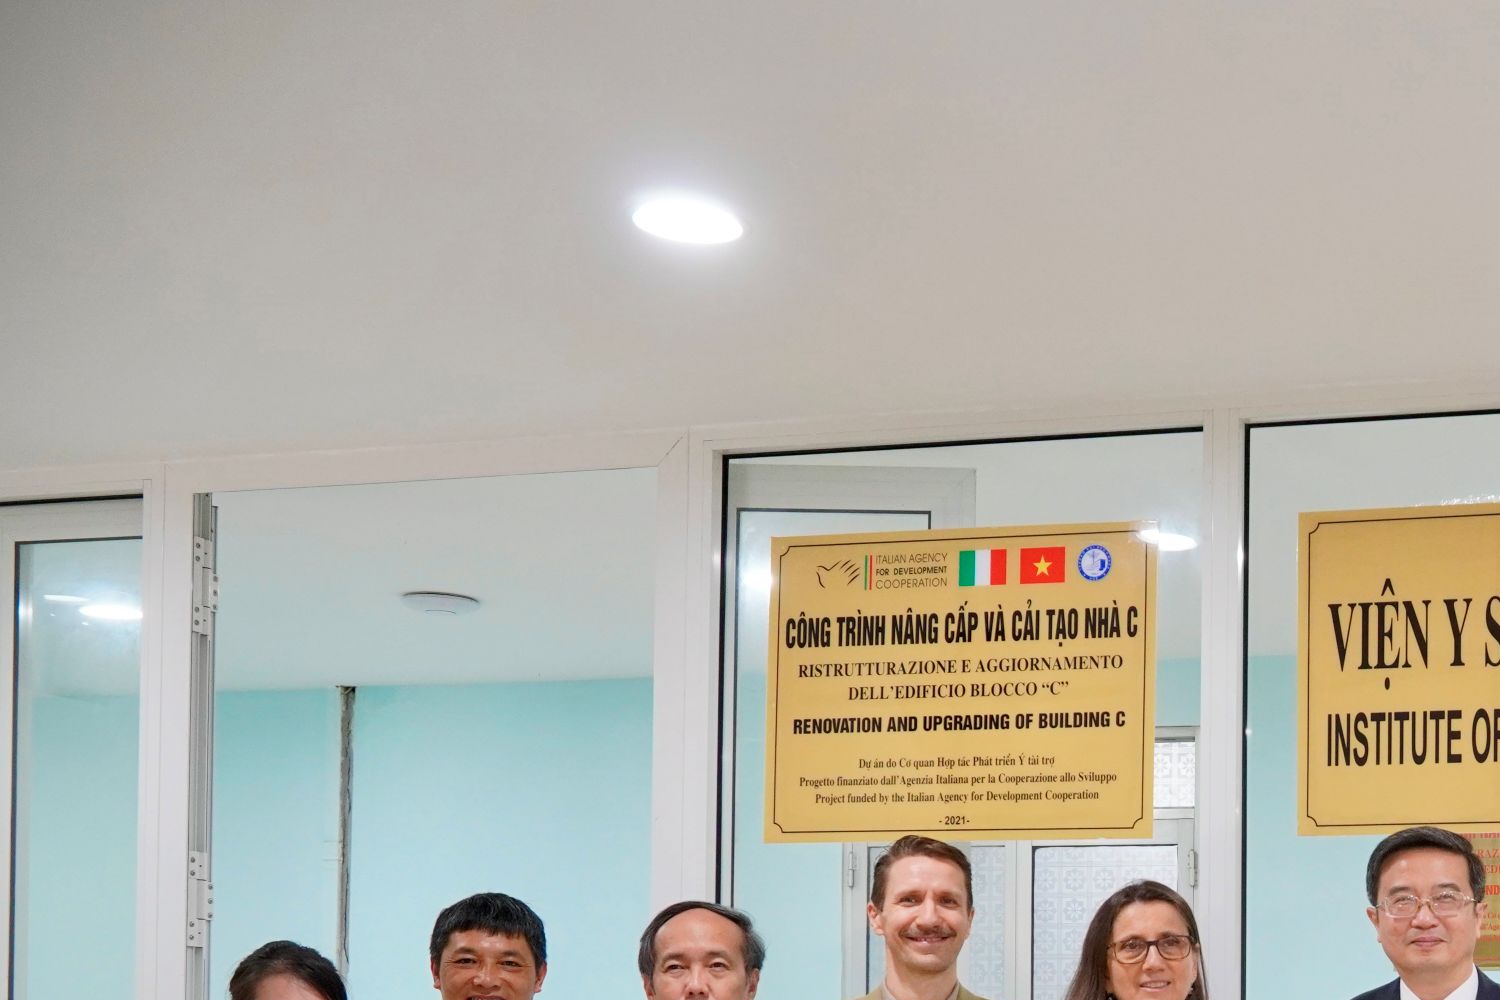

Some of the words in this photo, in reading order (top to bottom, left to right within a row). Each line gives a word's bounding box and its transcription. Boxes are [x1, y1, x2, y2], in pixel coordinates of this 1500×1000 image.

[876, 554, 906, 564] ITALIAN
[908, 552, 948, 563] AGENCY
[876, 568, 889, 576] FOR
[894, 566, 947, 576] DEVELOPMENT
[876, 578, 948, 590] COOPERATION
[786, 611, 830, 648] CÔNG
[836, 609, 886, 646] TRÌNH
[891, 607, 938, 644] NÂNG
[944, 601, 978, 643] CẤP
[984, 604, 1006, 642] VÀ
[1012, 599, 1040, 641] CẢI
[1046, 608, 1078, 646] TẠO
[1084, 600, 1120, 638] NHÀ
[1127, 606, 1138, 638] C
[1328, 578, 1431, 690] VIỆN
[1444, 598, 1472, 666] Y
[798, 660, 956, 678] RISTRUTTURAZIONE
[961, 660, 971, 672] E
[975, 654, 1123, 672] AGGIORNAMENTO
[970, 682, 1037, 697] BLOCCO
[793, 717, 882, 734] RENOVATION
[887, 716, 918, 732] AND
[923, 714, 1010, 731] UPGRADING
[1015, 714, 1033, 730] OF
[1038, 712, 1110, 728] BUILDING
[1116, 711, 1126, 727] C
[1327, 710, 1463, 766] INSTITUTE
[859, 758, 872, 771] Dự
[874, 758, 884, 768] án
[886, 758, 896, 768] do
[900, 758, 912, 768] Cơ
[914, 759, 934, 770] quan
[938, 757, 955, 770] Hợp
[958, 756, 970, 767] tác
[973, 756, 992, 766] Phát
[995, 754, 1016, 766] triển
[1018, 752, 1025, 766] Ý
[1028, 756, 1039, 765] tài
[1042, 756, 1055, 768] trợ
[800, 776, 834, 789] Progetto
[836, 776, 878, 786] finanziato
[936, 774, 968, 784] Italiana
[971, 776, 985, 786] per
[988, 774, 996, 783] la
[998, 773, 1058, 785] Cooperazione
[1060, 772, 1076, 782] allo
[1078, 772, 1117, 784] Sviluppo
[816, 793, 845, 805] Project
[848, 793, 876, 803] funded
[879, 793, 888, 804] by
[892, 793, 904, 802] the
[907, 792, 934, 802] Italian
[938, 792, 968, 804] Agency
[971, 791, 984, 801] for
[986, 790, 1042, 802] Development
[1045, 789, 1099, 802] Cooperation
[1485, 885, 1500, 895] ND
